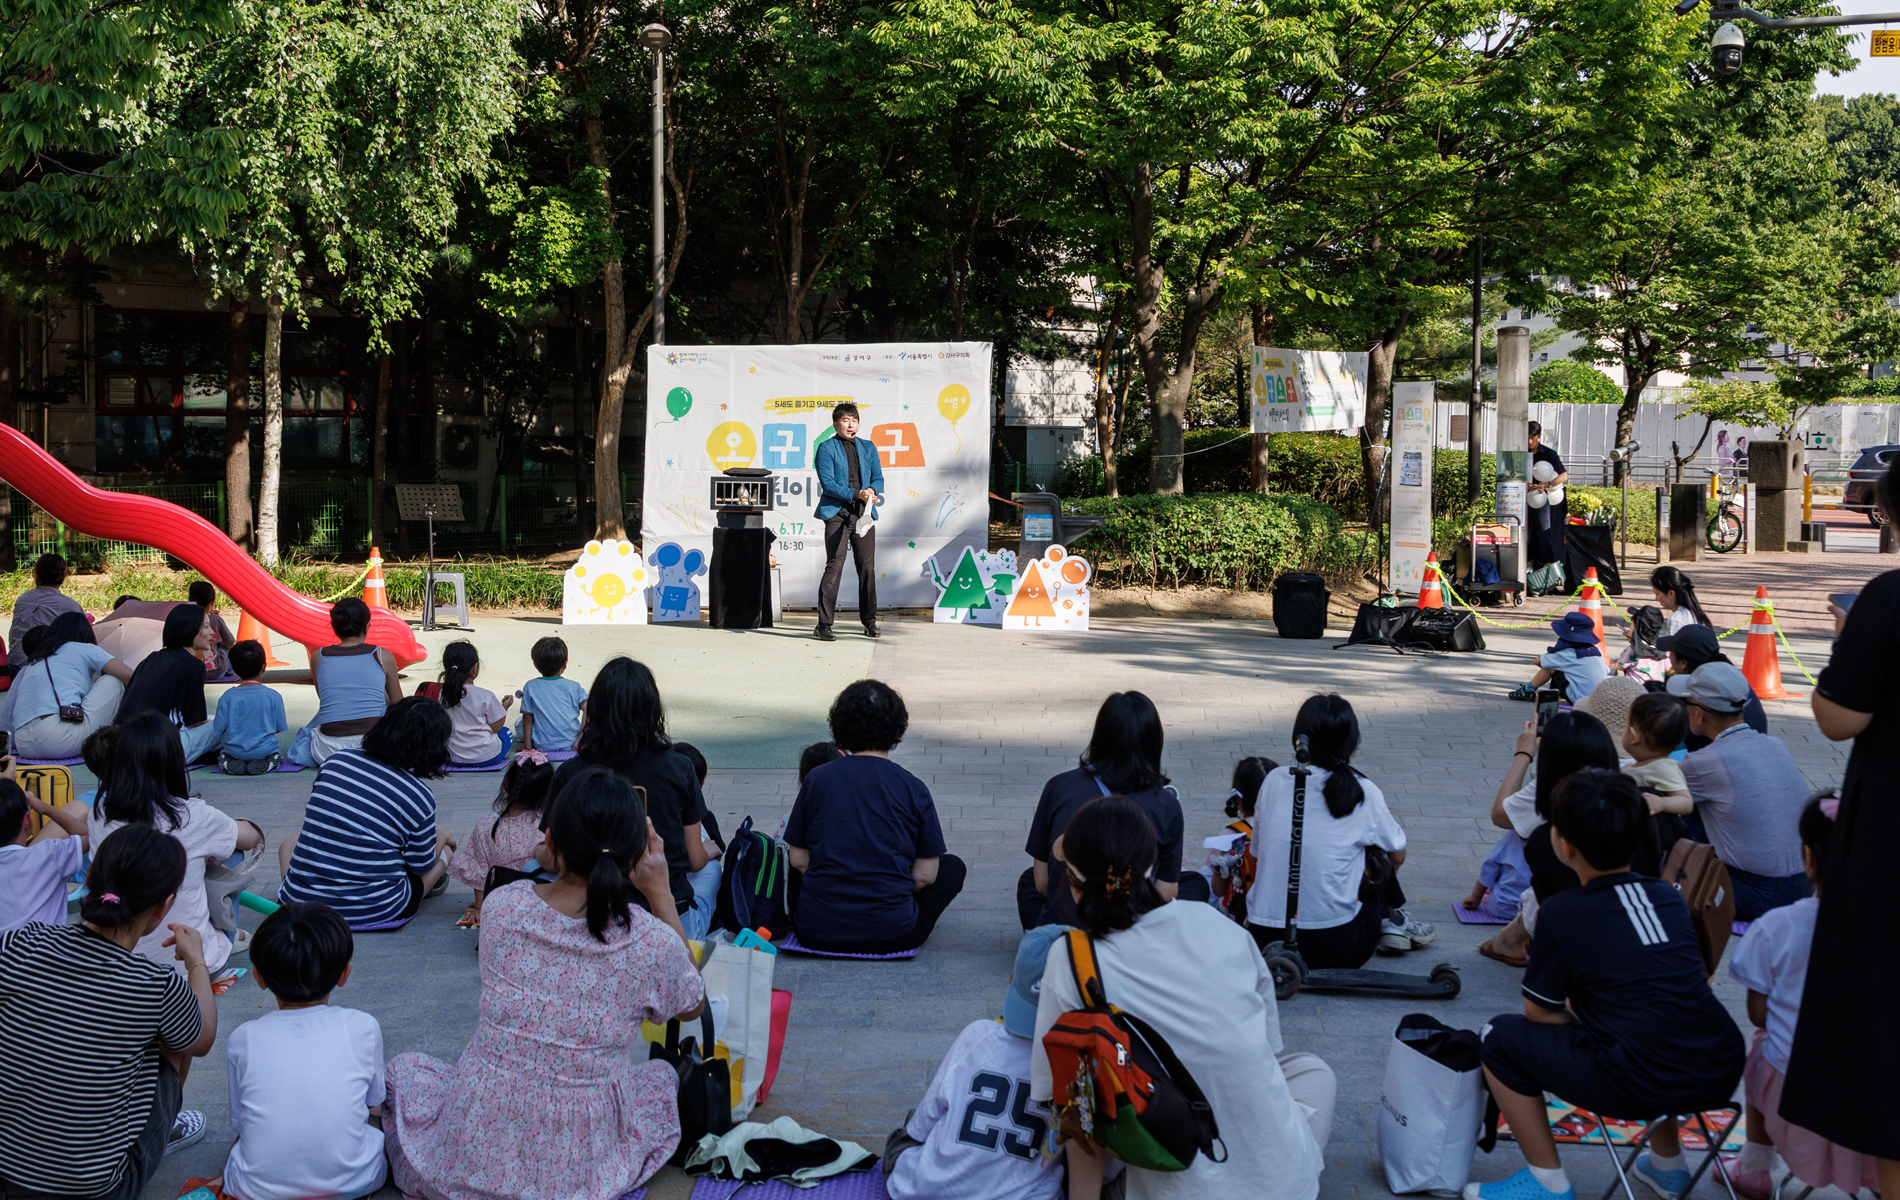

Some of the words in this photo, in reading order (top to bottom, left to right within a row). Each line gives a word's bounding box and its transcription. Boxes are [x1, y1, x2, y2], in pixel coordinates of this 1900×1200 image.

[945, 352, 971, 360] 강서구의회
[774, 400, 793, 408] 5세도
[795, 400, 815, 408] 즐기고
[816, 400, 836, 408] 9세도
[779, 522, 807, 536] 6.17.
[778, 541, 804, 551] 16:30
[956, 1069, 1053, 1163] 25
